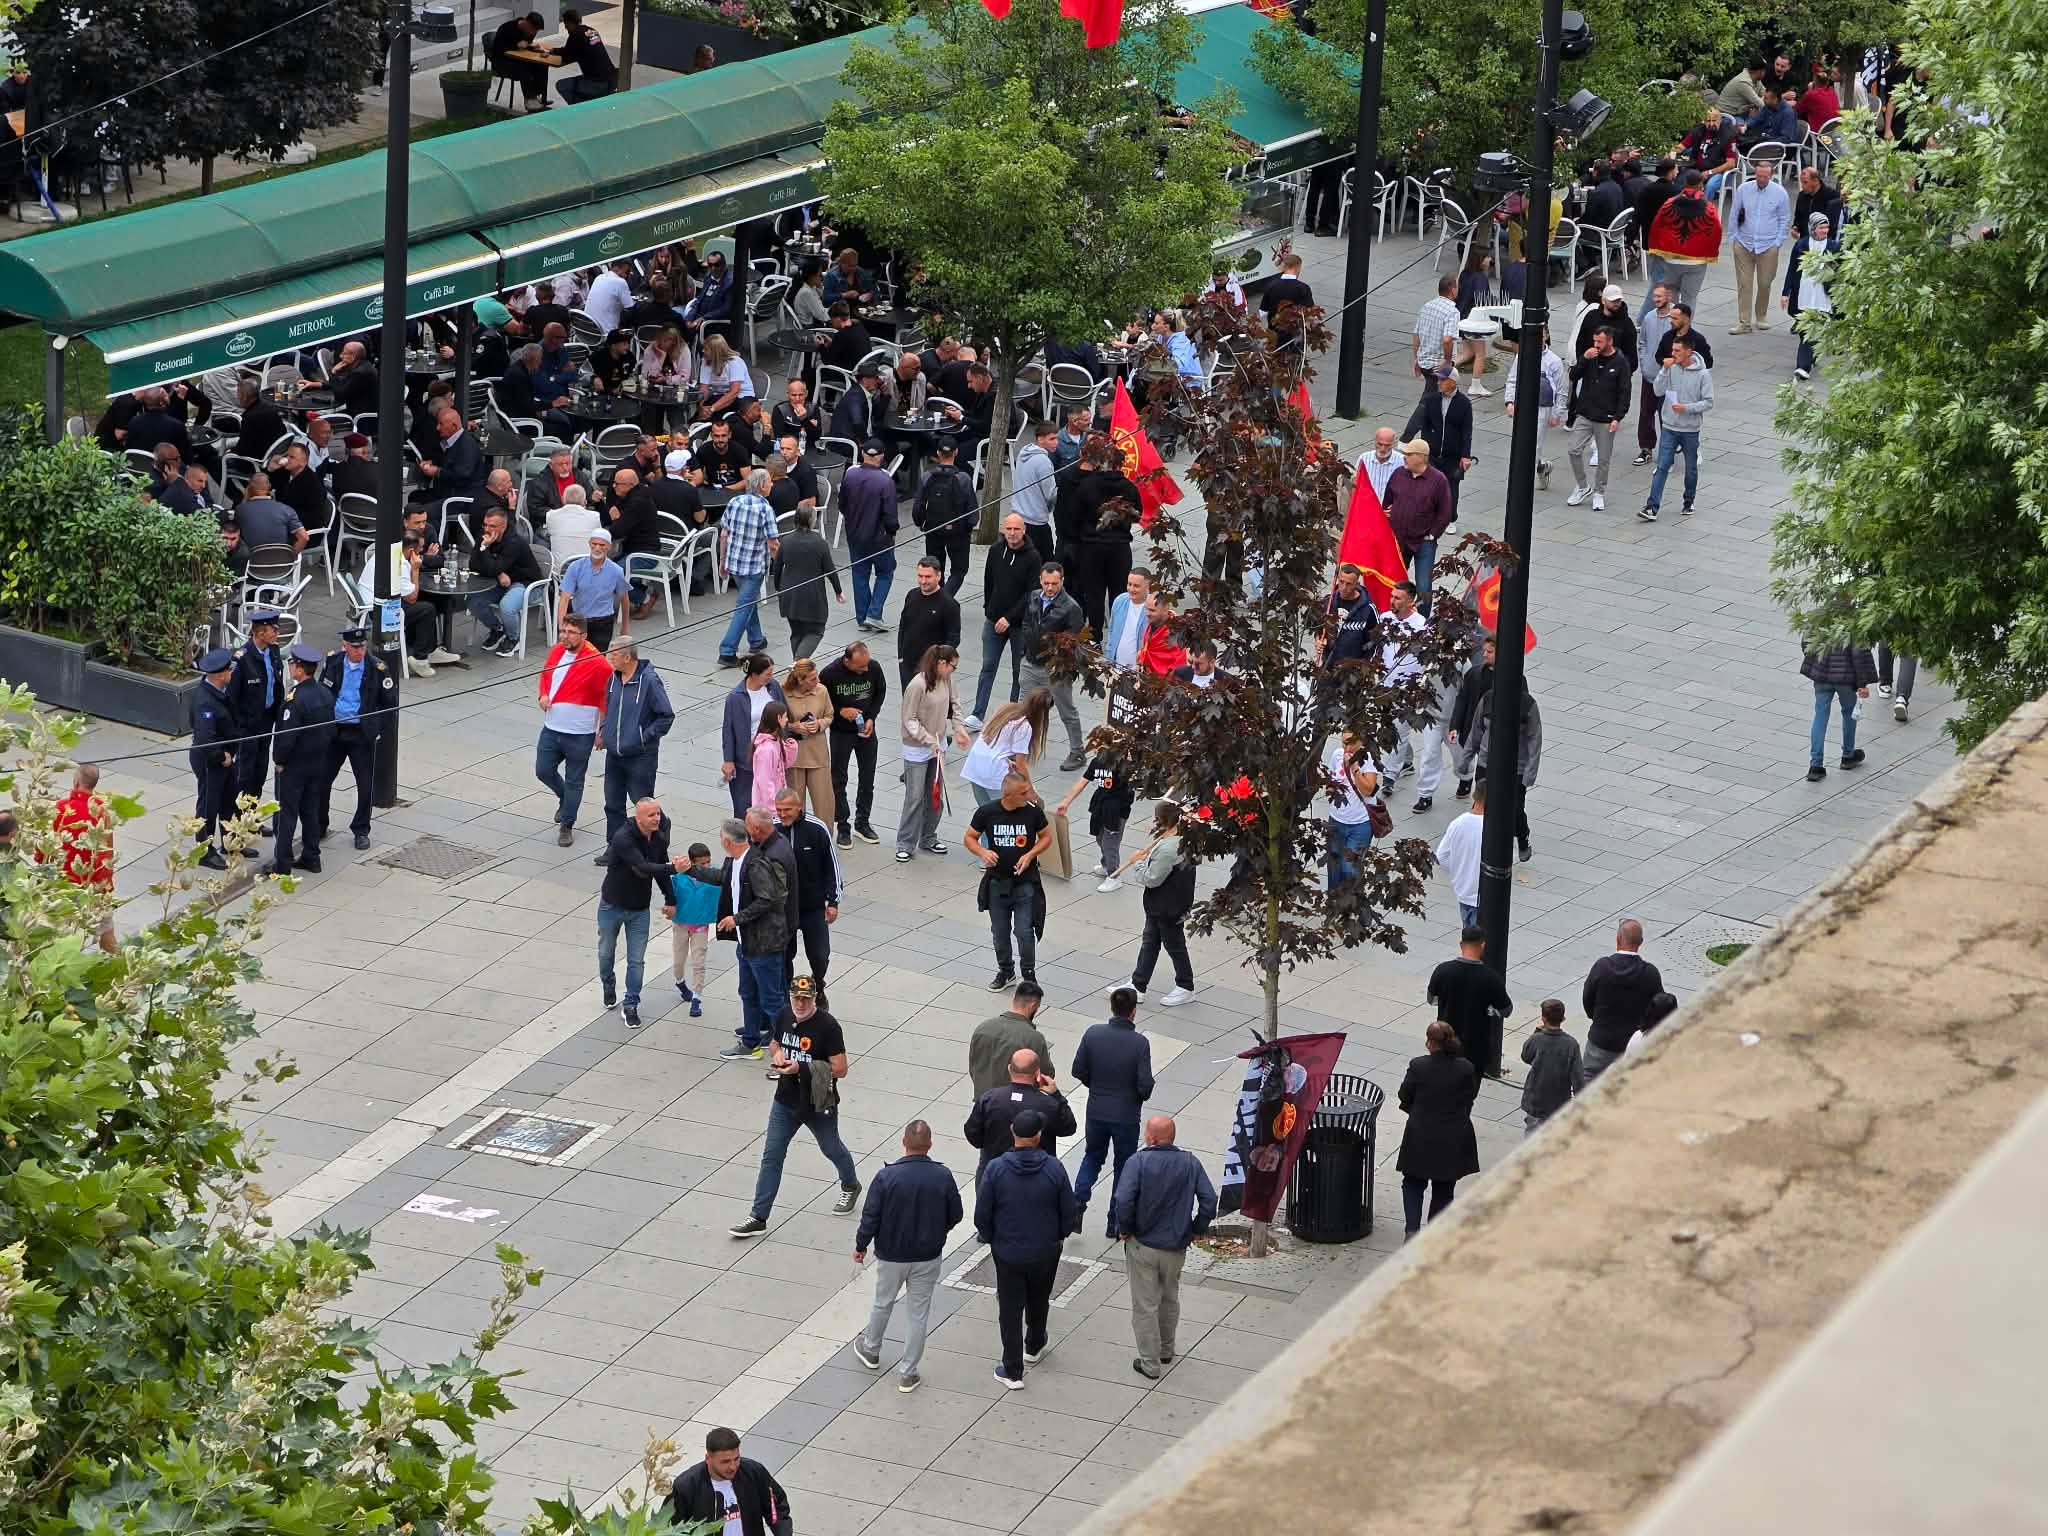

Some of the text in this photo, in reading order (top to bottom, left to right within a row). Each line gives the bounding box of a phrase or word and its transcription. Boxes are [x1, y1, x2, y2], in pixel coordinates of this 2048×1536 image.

[653, 216, 691, 236] METROPOL
[542, 249, 575, 268] Restoranti
[443, 285, 456, 296] Bar
[288, 315, 336, 338] METROPOL
[229, 342, 252, 353] Metropol
[154, 353, 193, 373] Restoranti
[1015, 824, 1027, 836] KA
